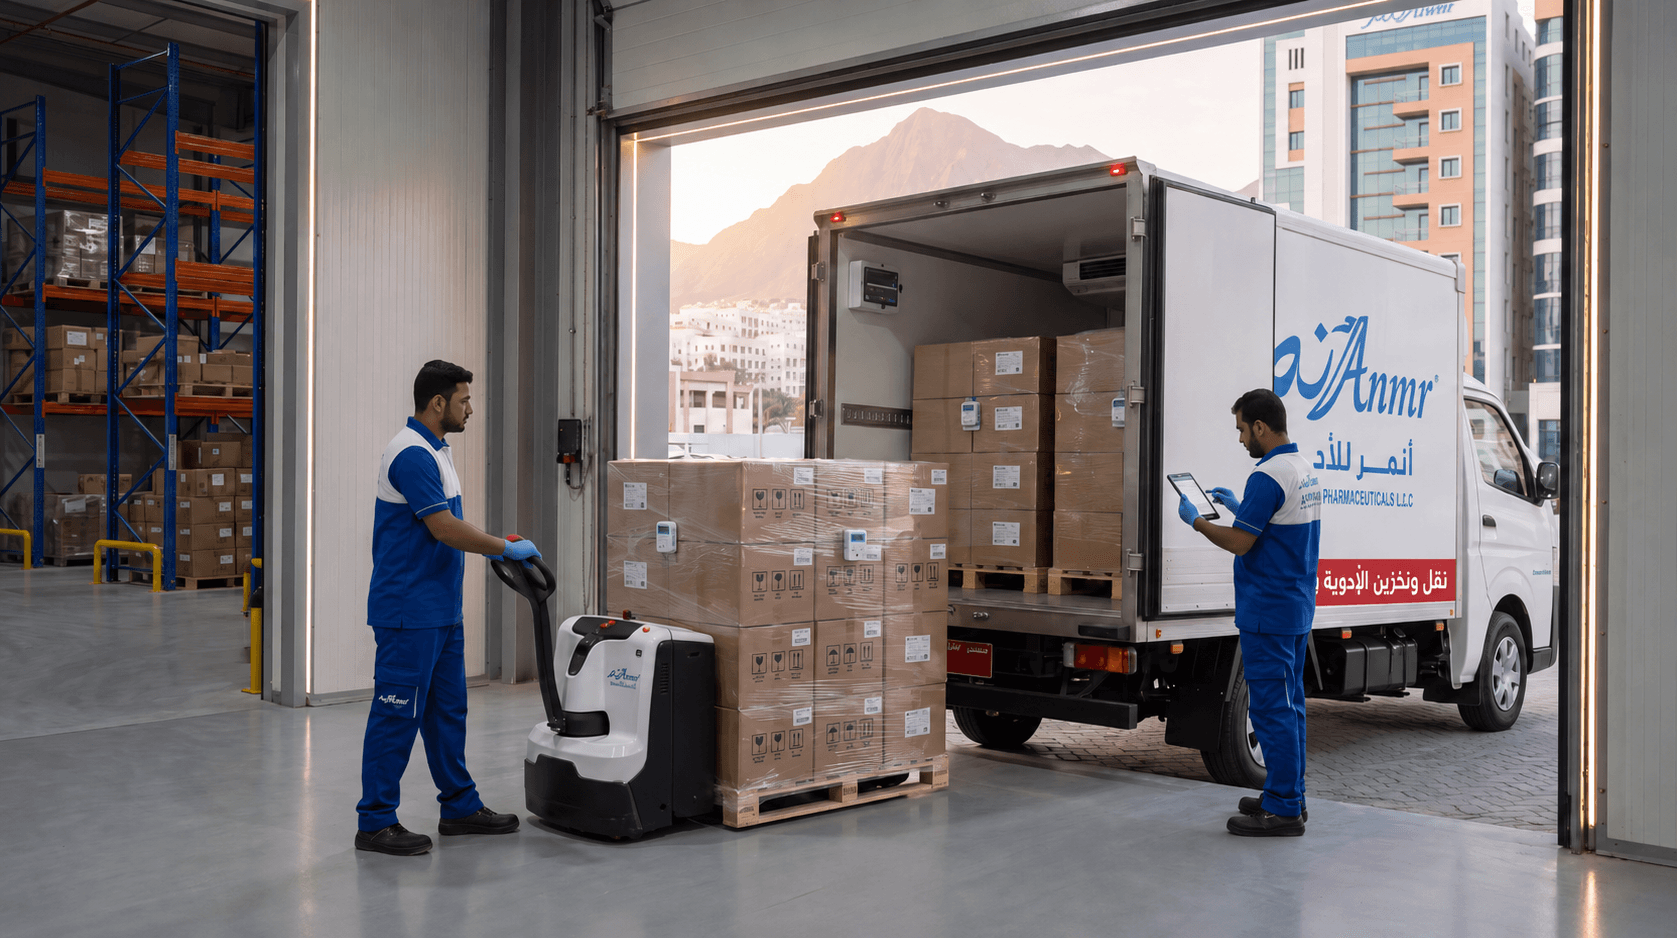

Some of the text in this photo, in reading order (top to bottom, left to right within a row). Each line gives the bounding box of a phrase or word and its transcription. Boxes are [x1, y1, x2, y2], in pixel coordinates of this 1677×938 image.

[1312, 431, 1413, 481] أنمر للأد
[1322, 488, 1395, 507] PHARMACEUTICALS
[1423, 568, 1448, 595] نقل
